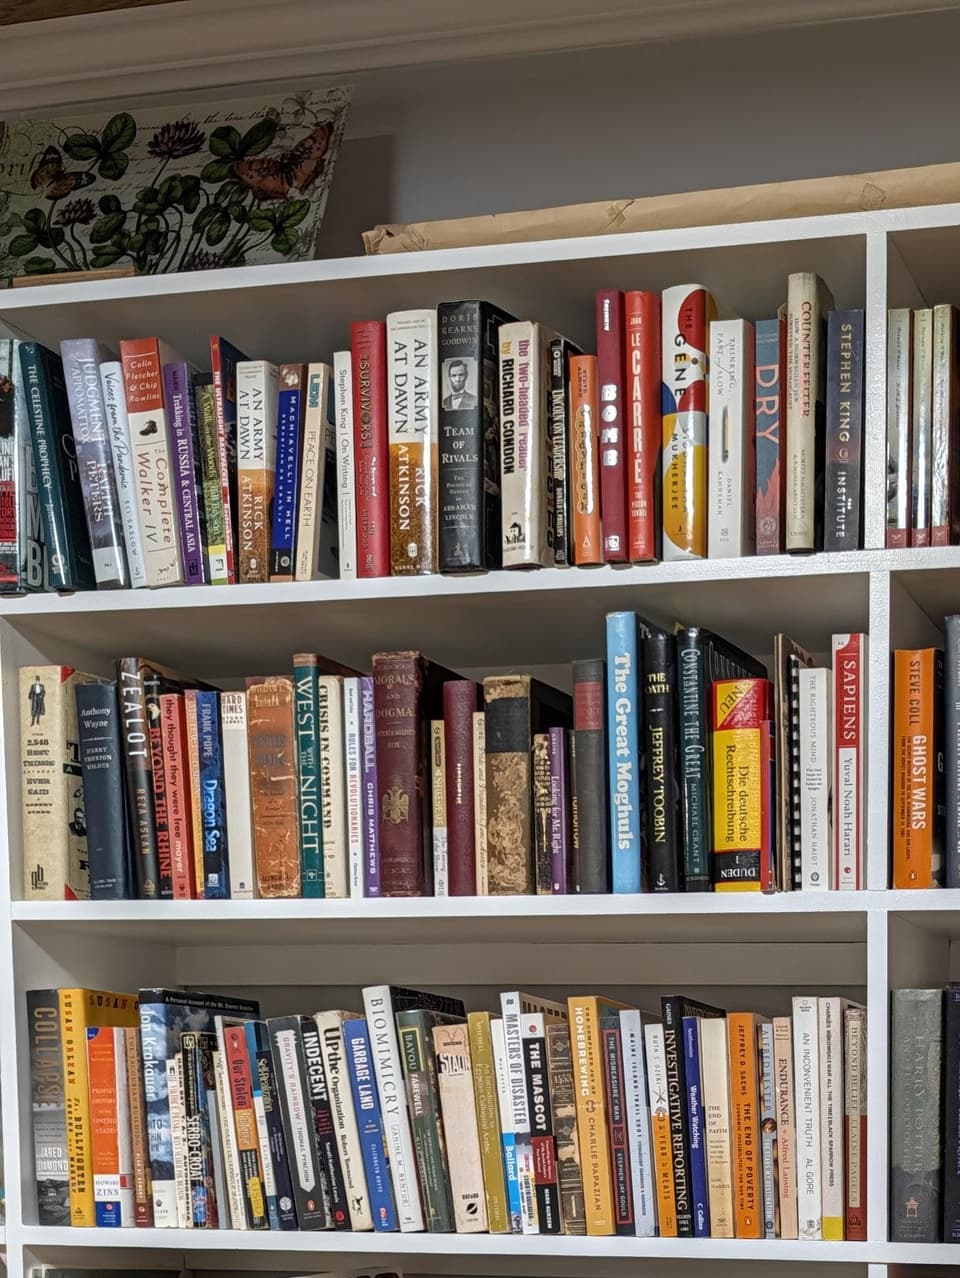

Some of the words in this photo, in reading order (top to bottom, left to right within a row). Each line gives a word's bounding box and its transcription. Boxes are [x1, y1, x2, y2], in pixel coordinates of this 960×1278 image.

[394, 341, 407, 366] AT
[414, 338, 427, 368] AN
[674, 334, 686, 397] GENE
[802, 301, 812, 417] COUNTERFEITER
[840, 324, 852, 393] STEPHEN
[395, 374, 408, 434] DAWN
[414, 376, 428, 436] ARMY
[756, 364, 779, 444] DRY
[839, 402, 850, 443] KING
[137, 451, 152, 519] Walker
[146, 523, 158, 544] IV
[154, 458, 172, 544] Complete
[399, 444, 410, 531] ATKINSON
[836, 472, 846, 538] INSTITUTE
[614, 653, 632, 693] The
[843, 661, 856, 741] SAPIENS
[908, 661, 921, 694] STEVE
[121, 672, 148, 758] ZEALOT
[296, 675, 315, 741] WEST
[615, 698, 632, 758] Great
[909, 698, 920, 727] COLL
[738, 766, 748, 788] Die
[912, 735, 927, 784] GHOST
[204, 780, 218, 828] Dragon
[300, 775, 318, 853] NIGHT
[616, 761, 634, 851] Moghuls
[724, 745, 736, 843] Rechtschreibung
[738, 790, 748, 842] deutsche
[912, 788, 926, 830] WARS
[206, 830, 217, 852] Sea
[721, 868, 756, 878] DUDEN
[303, 1031, 326, 1101] INDECENT
[351, 1037, 369, 1084] GARBAGE
[371, 998, 400, 1116] BIOMIMICRY
[530, 1043, 541, 1069] THE
[575, 1007, 590, 1096] HOMEBREWING
[665, 1030, 684, 1128] INVESTIGATIVE
[359, 1087, 374, 1110] LAND
[531, 1075, 546, 1131] MASCOT
[671, 1131, 688, 1210] REPORTING
